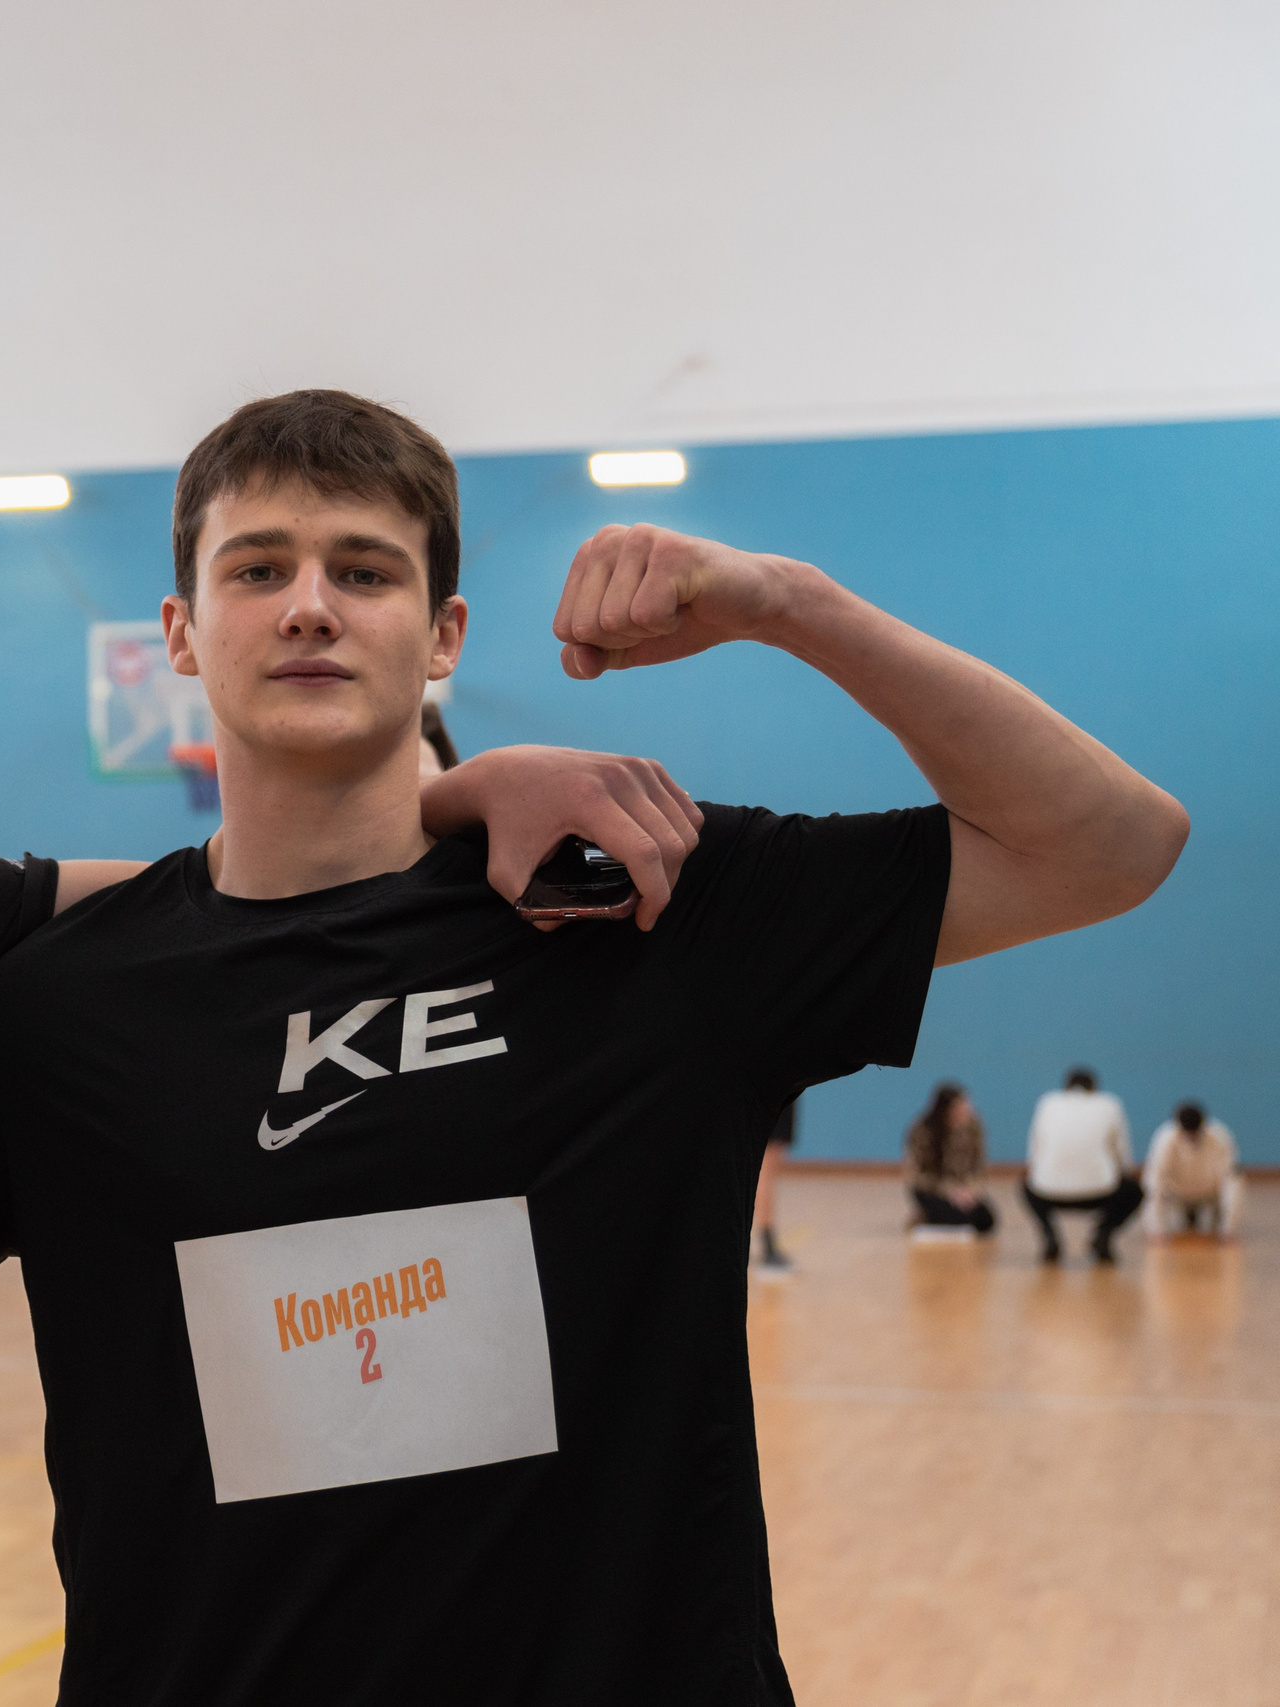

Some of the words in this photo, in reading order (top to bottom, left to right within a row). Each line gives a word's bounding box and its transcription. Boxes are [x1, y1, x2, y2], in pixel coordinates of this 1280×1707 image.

[277, 979, 508, 1094] KE
[273, 1257, 448, 1353] Команда
[355, 1328, 383, 1385] 2
